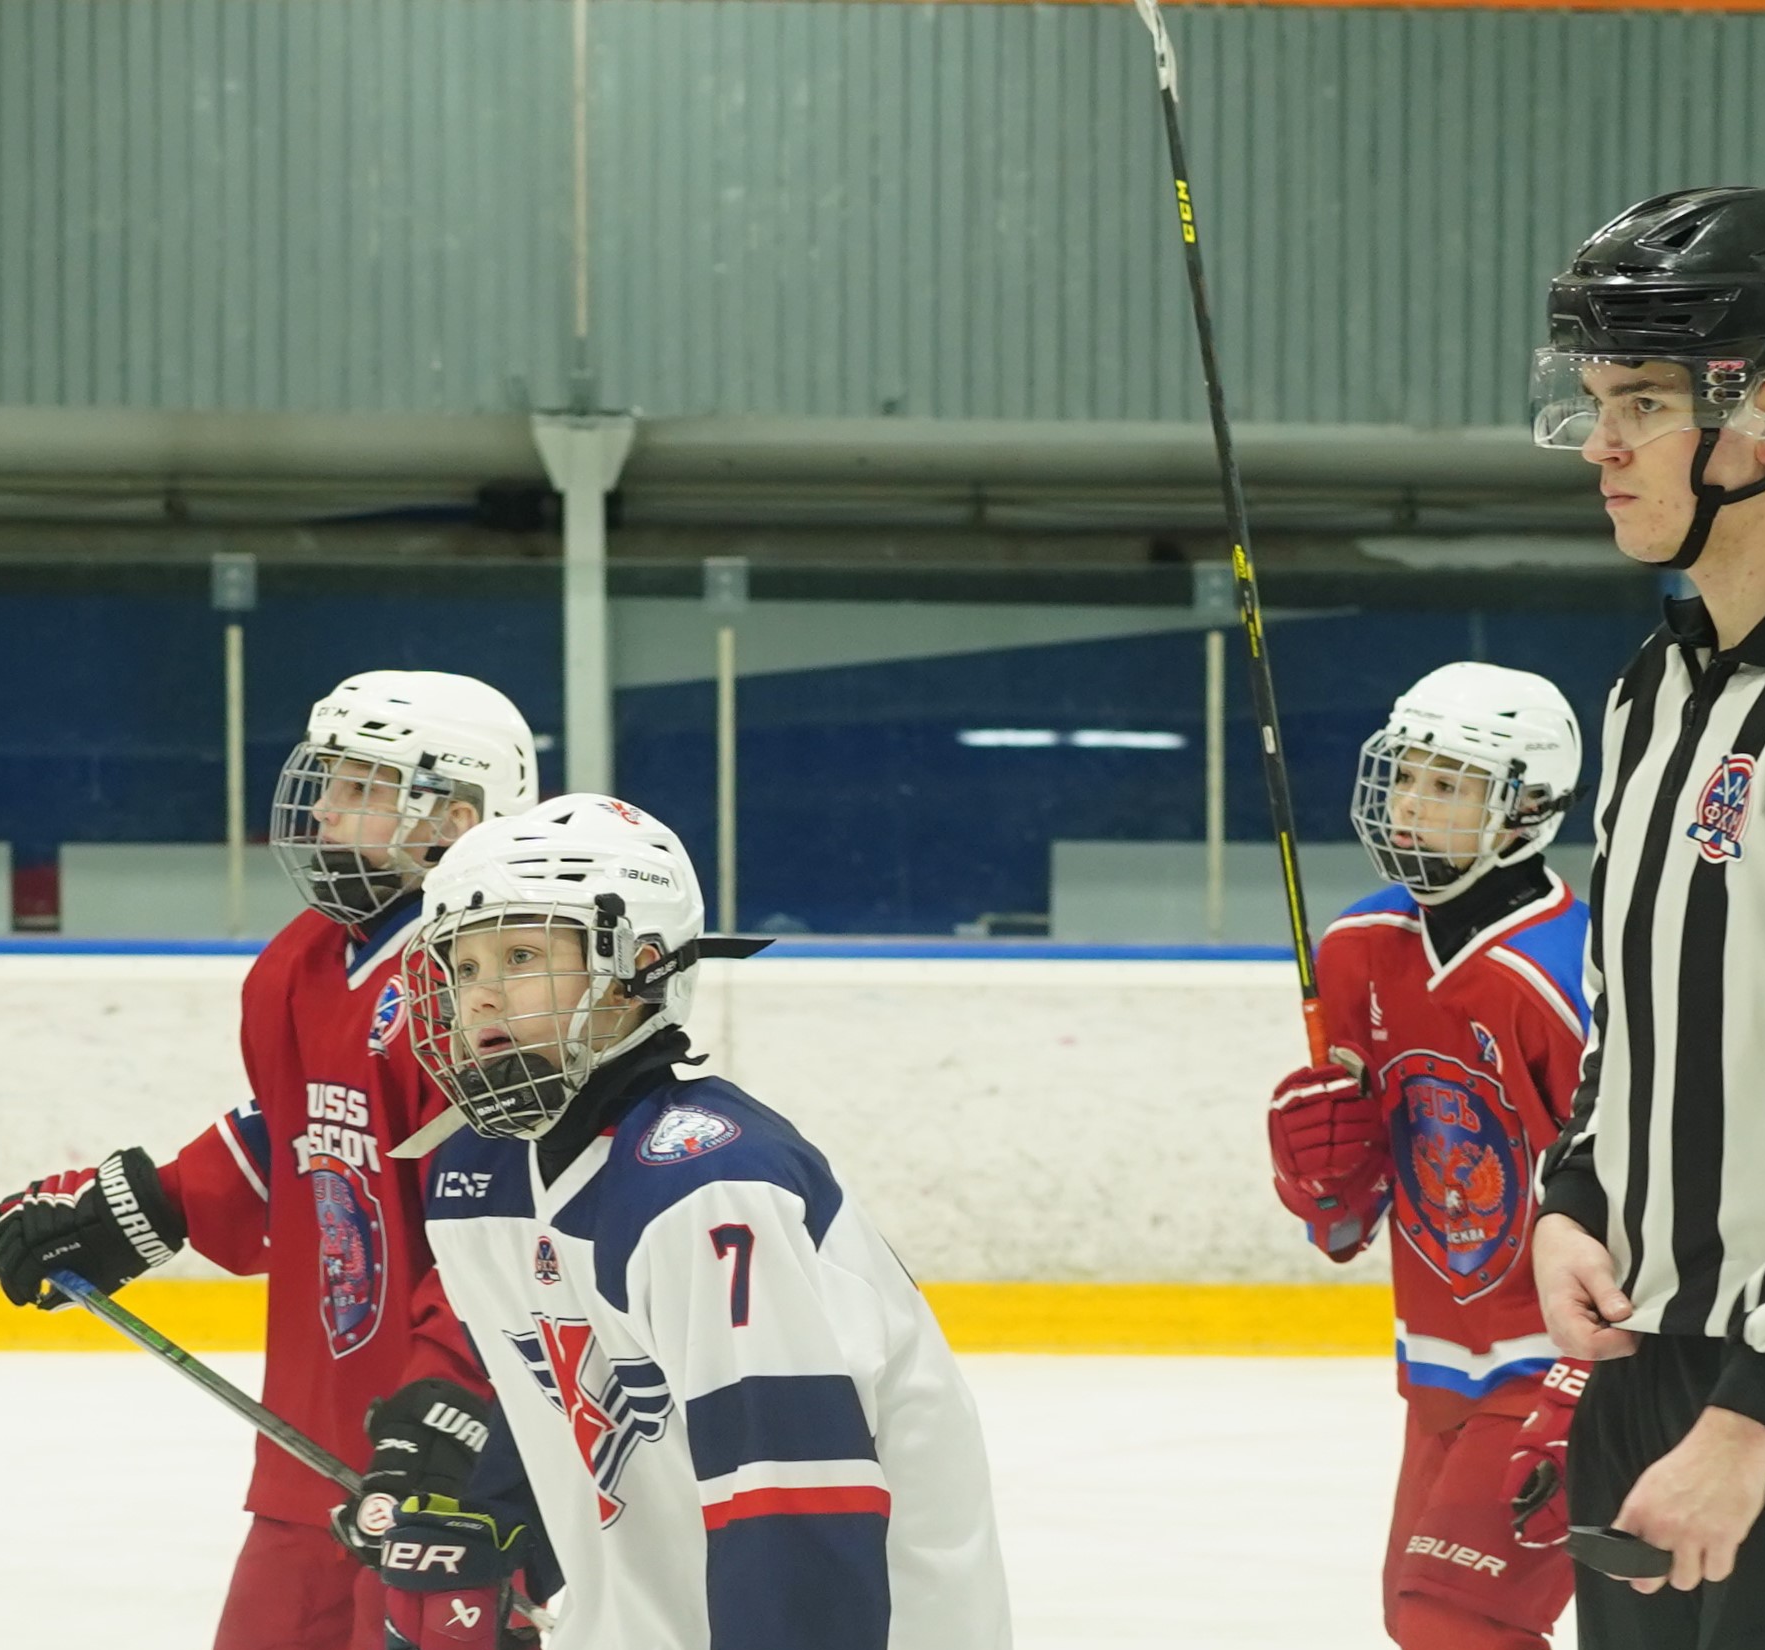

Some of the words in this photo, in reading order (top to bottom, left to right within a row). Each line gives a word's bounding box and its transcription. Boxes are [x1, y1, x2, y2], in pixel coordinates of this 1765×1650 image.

[440, 752, 491, 771] CCM
[618, 867, 670, 888] BAUER
[99, 1154, 176, 1268] WARRIOR
[709, 1223, 755, 1329] 7
[1405, 1535, 1507, 1578] BAUER
